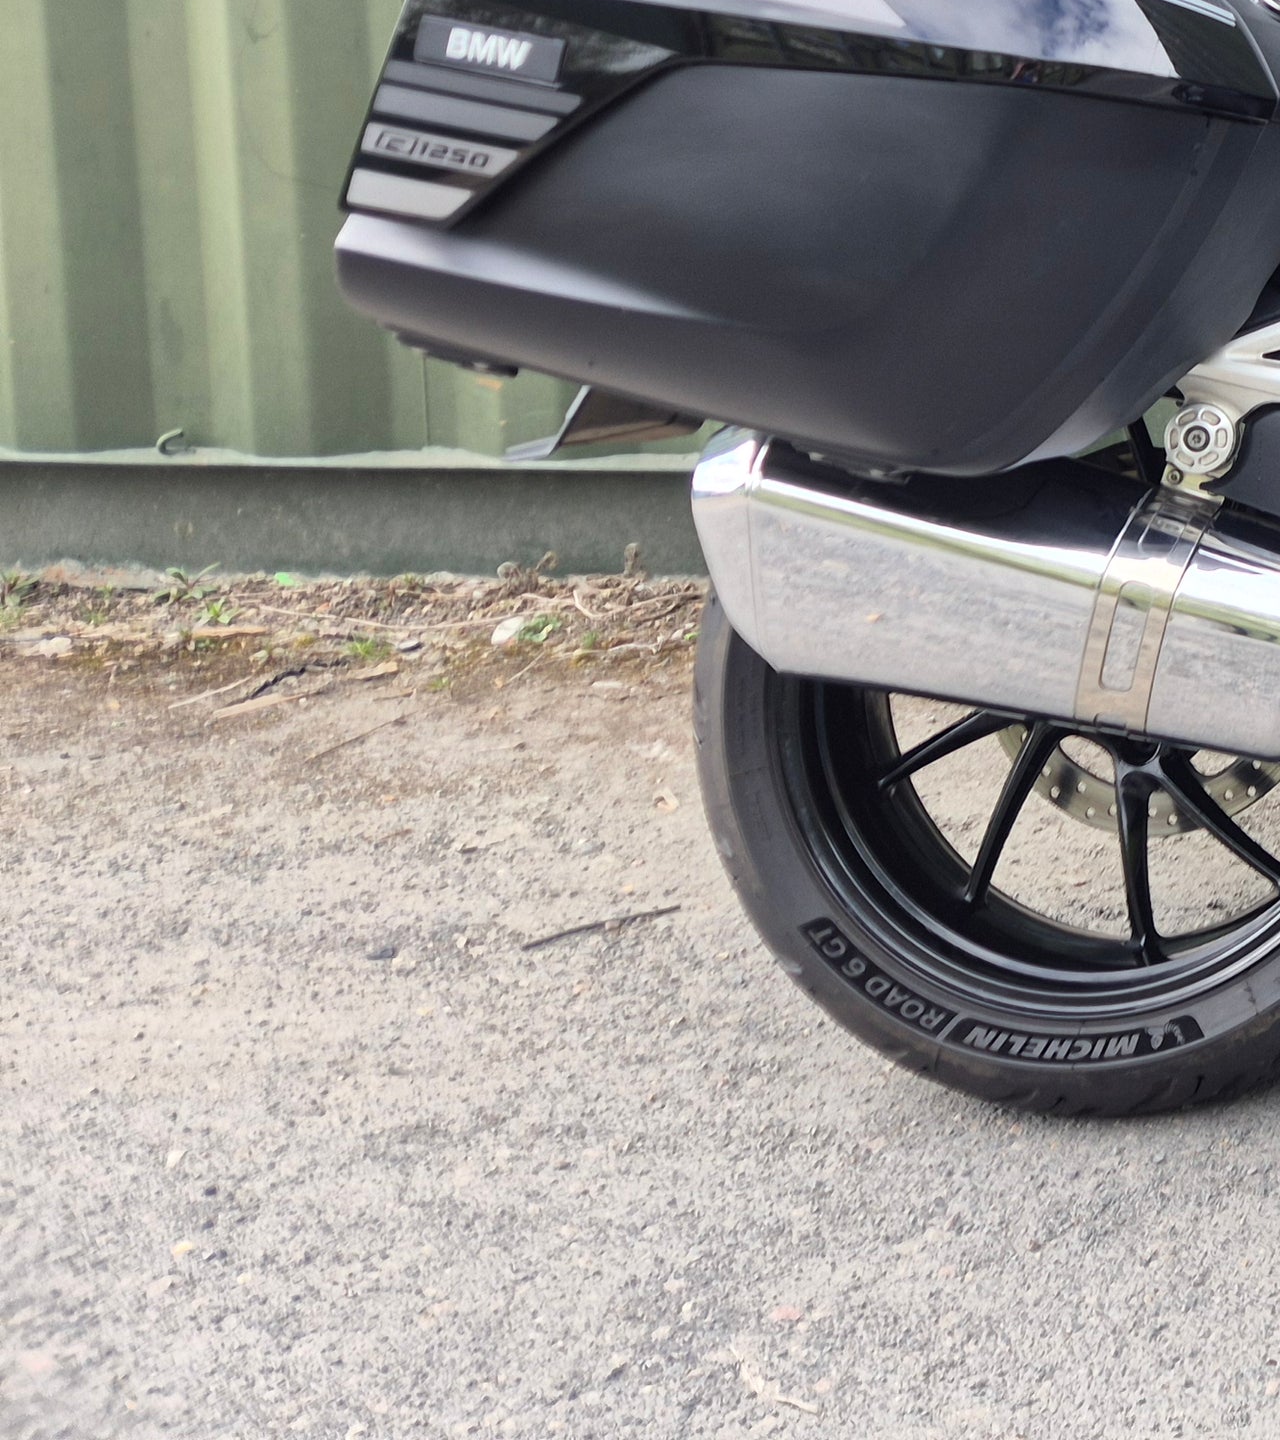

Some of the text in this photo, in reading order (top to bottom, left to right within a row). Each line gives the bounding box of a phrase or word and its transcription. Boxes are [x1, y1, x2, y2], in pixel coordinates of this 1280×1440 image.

[446, 27, 533, 71] BMW
[808, 927, 1140, 1061] MICHELIN ROAD 6 GT
